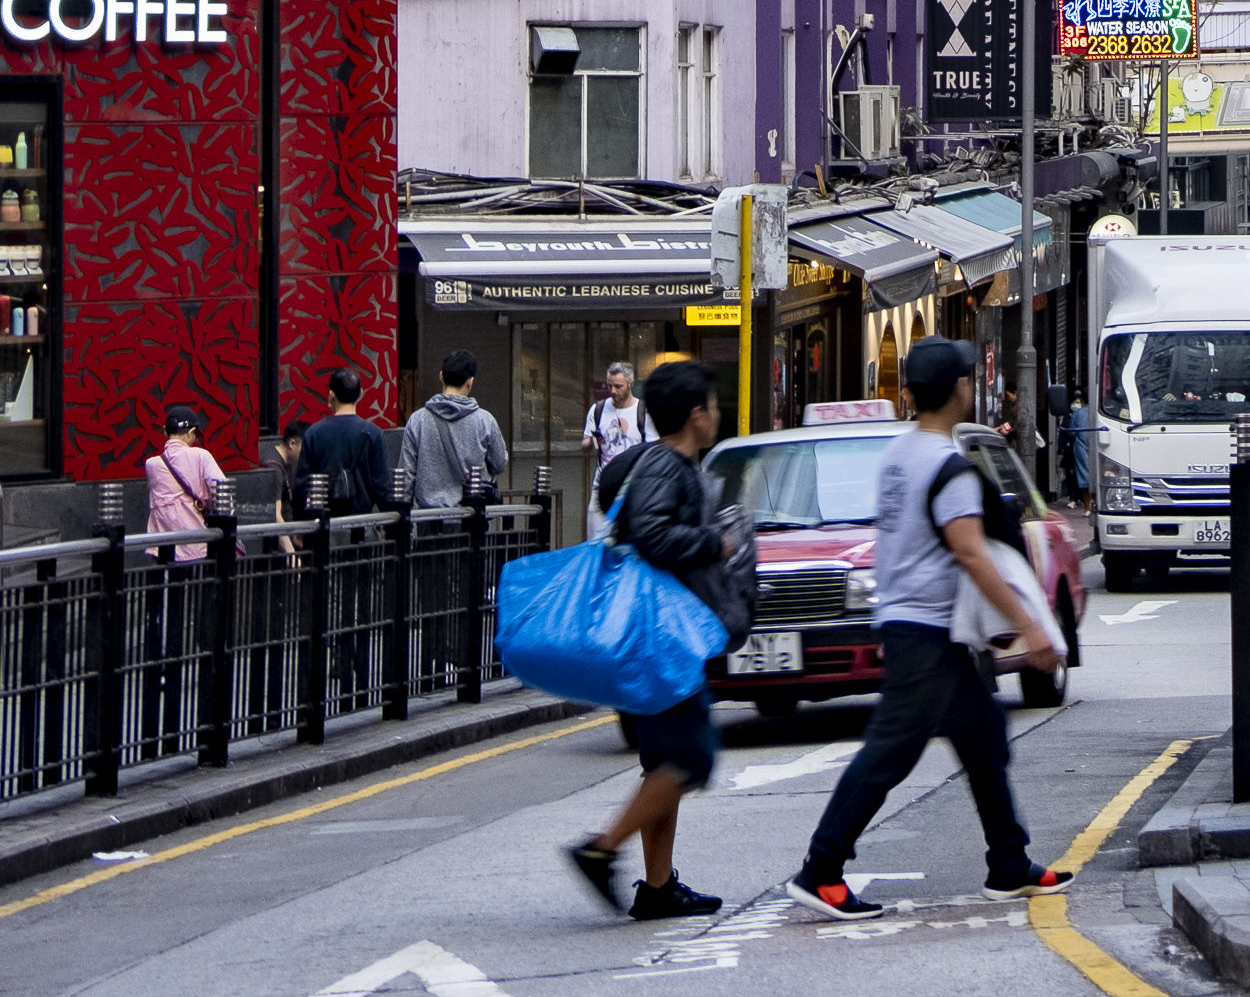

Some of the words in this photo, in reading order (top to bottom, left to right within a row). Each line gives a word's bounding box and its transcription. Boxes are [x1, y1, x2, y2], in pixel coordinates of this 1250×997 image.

[1065, 26, 1086, 38] 3F
[1087, 21, 1123, 36] WATER
[1126, 20, 1168, 35] SEASON
[1064, 38, 1088, 48] 306
[1088, 35, 1128, 54] 2368
[1131, 35, 1172, 54] 2632
[933, 71, 982, 89] TRUE
[435, 281, 458, 294] 961
[482, 286, 567, 298] AUTHENTIC
[572, 285, 650, 297] LEBANESE
[655, 284, 714, 296] CUISINE
[815, 401, 886, 421] TAXI
[1204, 520, 1222, 531] LA
[1196, 531, 1231, 541] 8962
